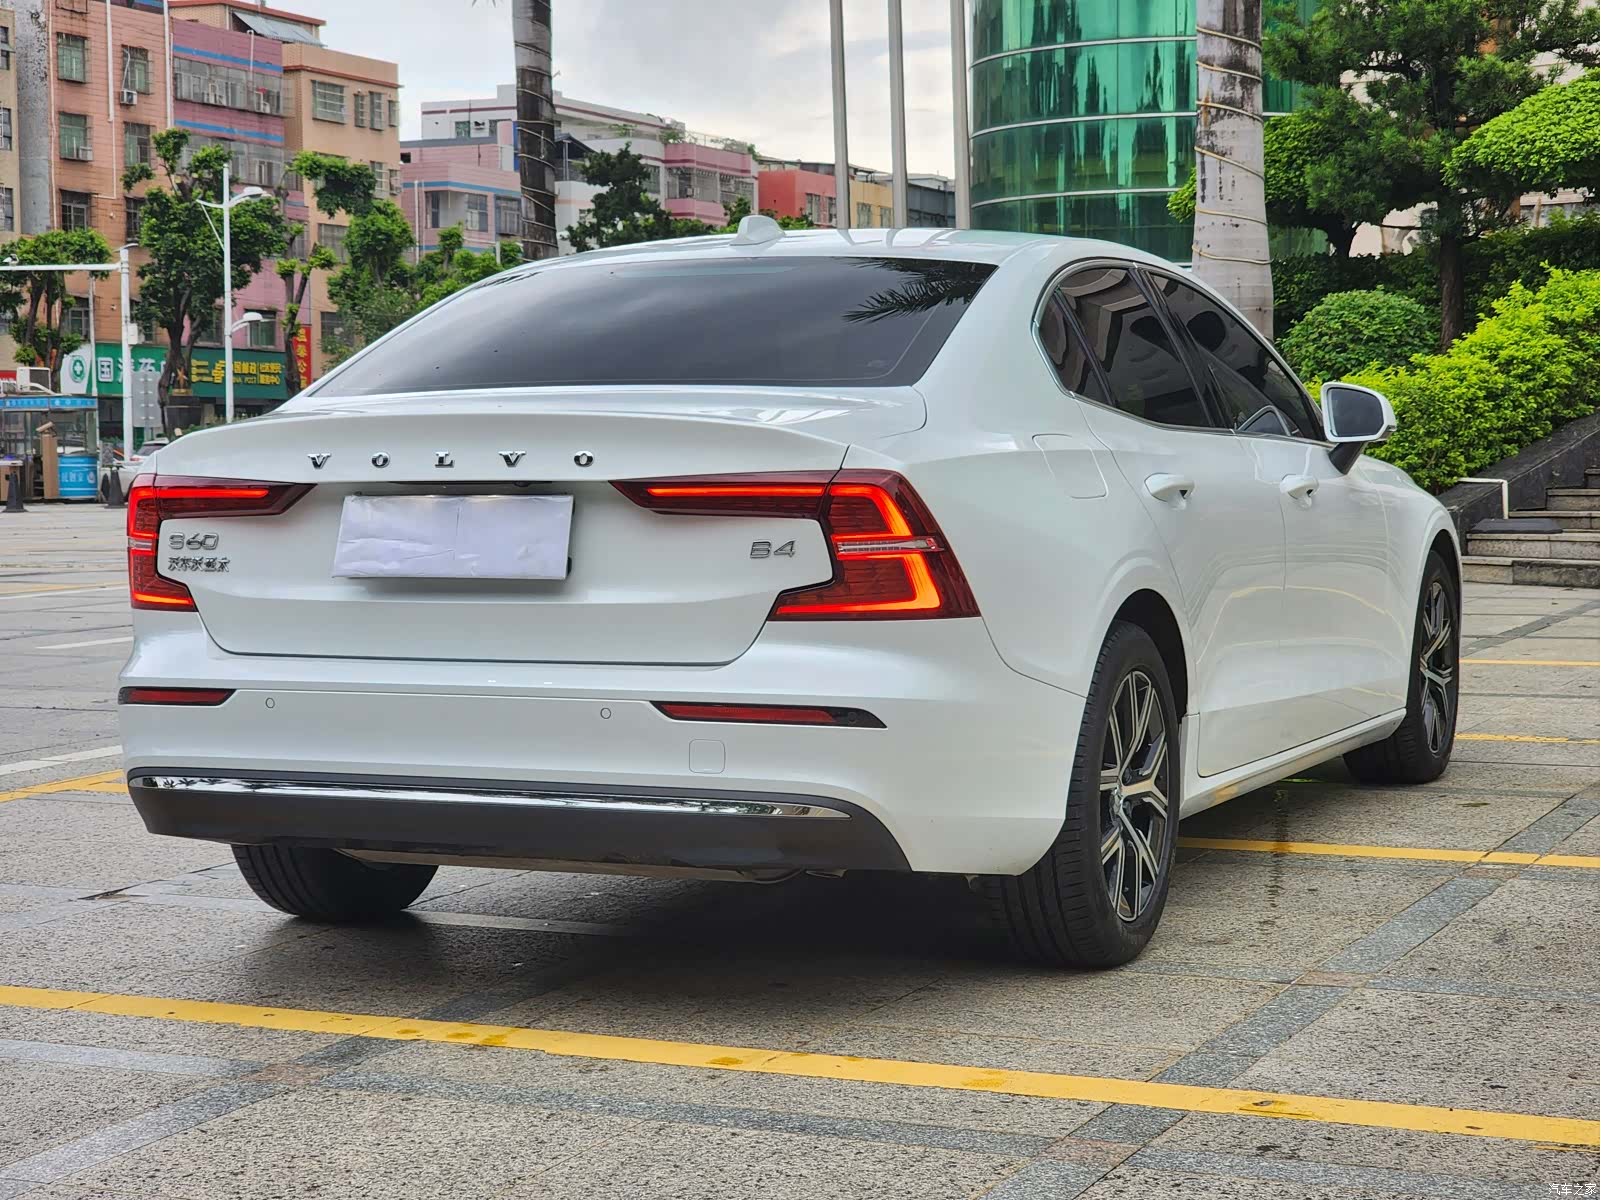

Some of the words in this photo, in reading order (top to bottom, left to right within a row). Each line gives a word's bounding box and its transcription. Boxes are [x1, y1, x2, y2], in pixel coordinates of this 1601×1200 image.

[307, 450, 595, 469] VOLVO
[168, 532, 219, 550] S60
[750, 539, 796, 559] B4
